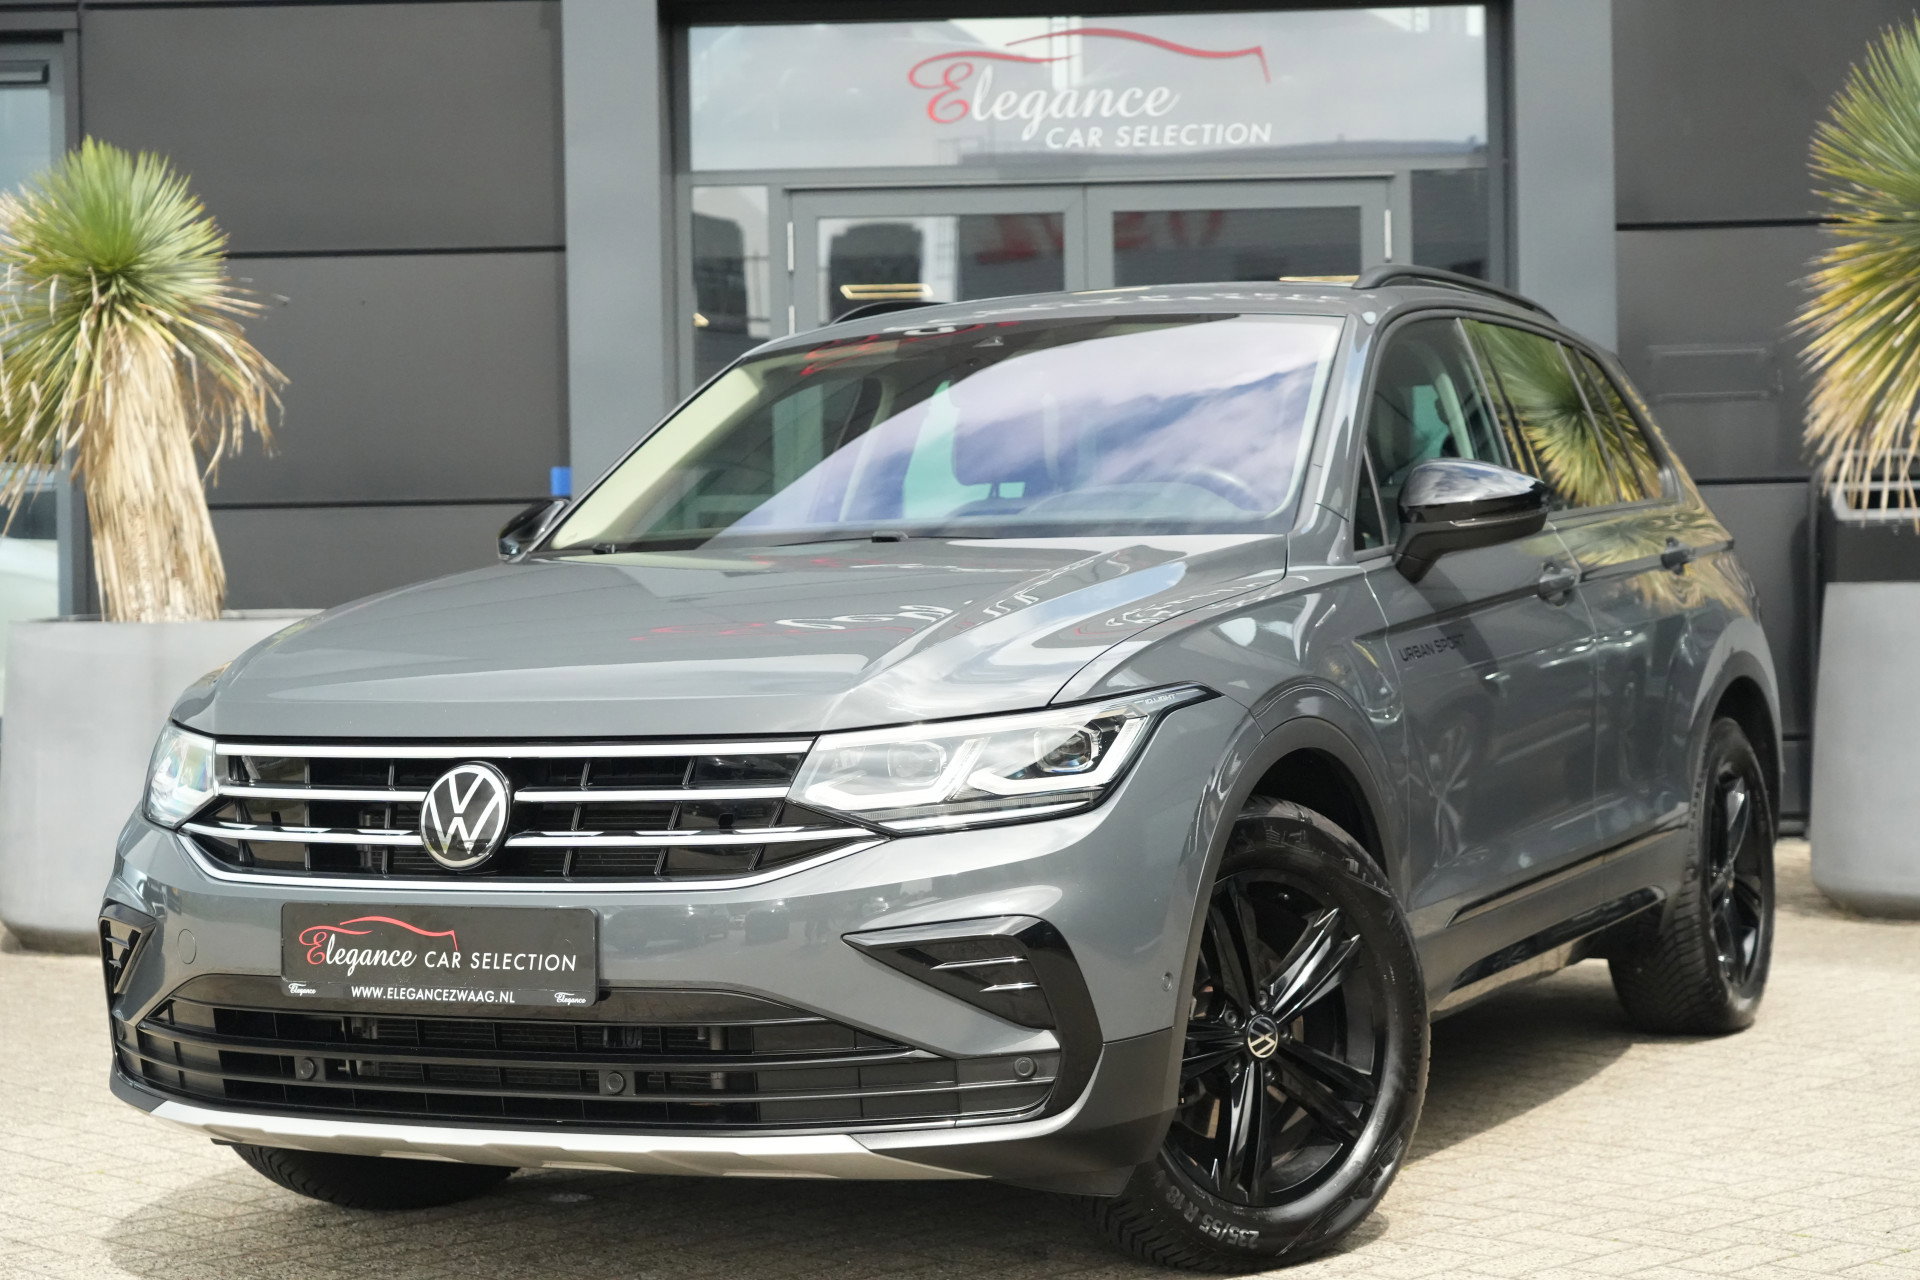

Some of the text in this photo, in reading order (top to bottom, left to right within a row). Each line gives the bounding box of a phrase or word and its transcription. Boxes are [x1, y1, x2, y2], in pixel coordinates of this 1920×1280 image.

[908, 55, 1181, 141] Elegance
[1046, 122, 1272, 149] CAR SELECTION
[1398, 642, 1436, 662] URBAN
[298, 926, 577, 976] Elegance CAR SELECTION
[288, 982, 317, 996] Elegance
[351, 985, 516, 1004] WWW.ELEGANCEZWAAG.NL
[554, 991, 587, 1005] Elegance
[1199, 1213, 1260, 1249] 235/55
